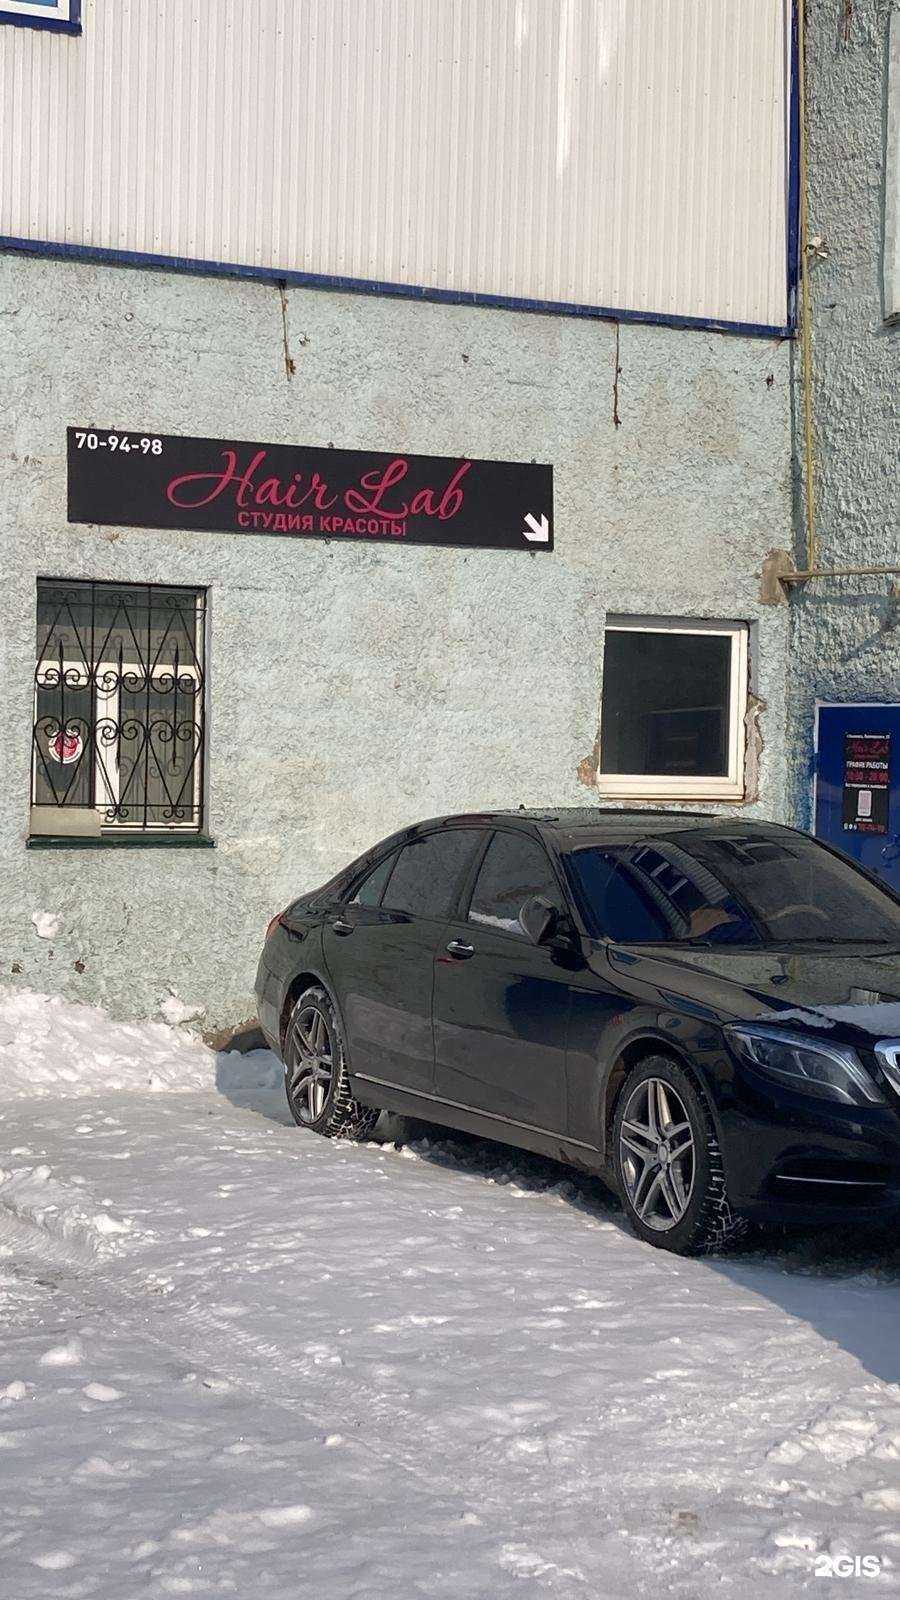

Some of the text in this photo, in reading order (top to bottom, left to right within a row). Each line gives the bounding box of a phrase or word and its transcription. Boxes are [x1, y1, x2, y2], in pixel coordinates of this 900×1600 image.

[75, 432, 164, 456] 70-94-98
[166, 450, 472, 520] Hair Lab
[237, 511, 407, 537] СТУДИЯ КРАСОТЫ
[866, 761, 889, 770] РАБОТЫ
